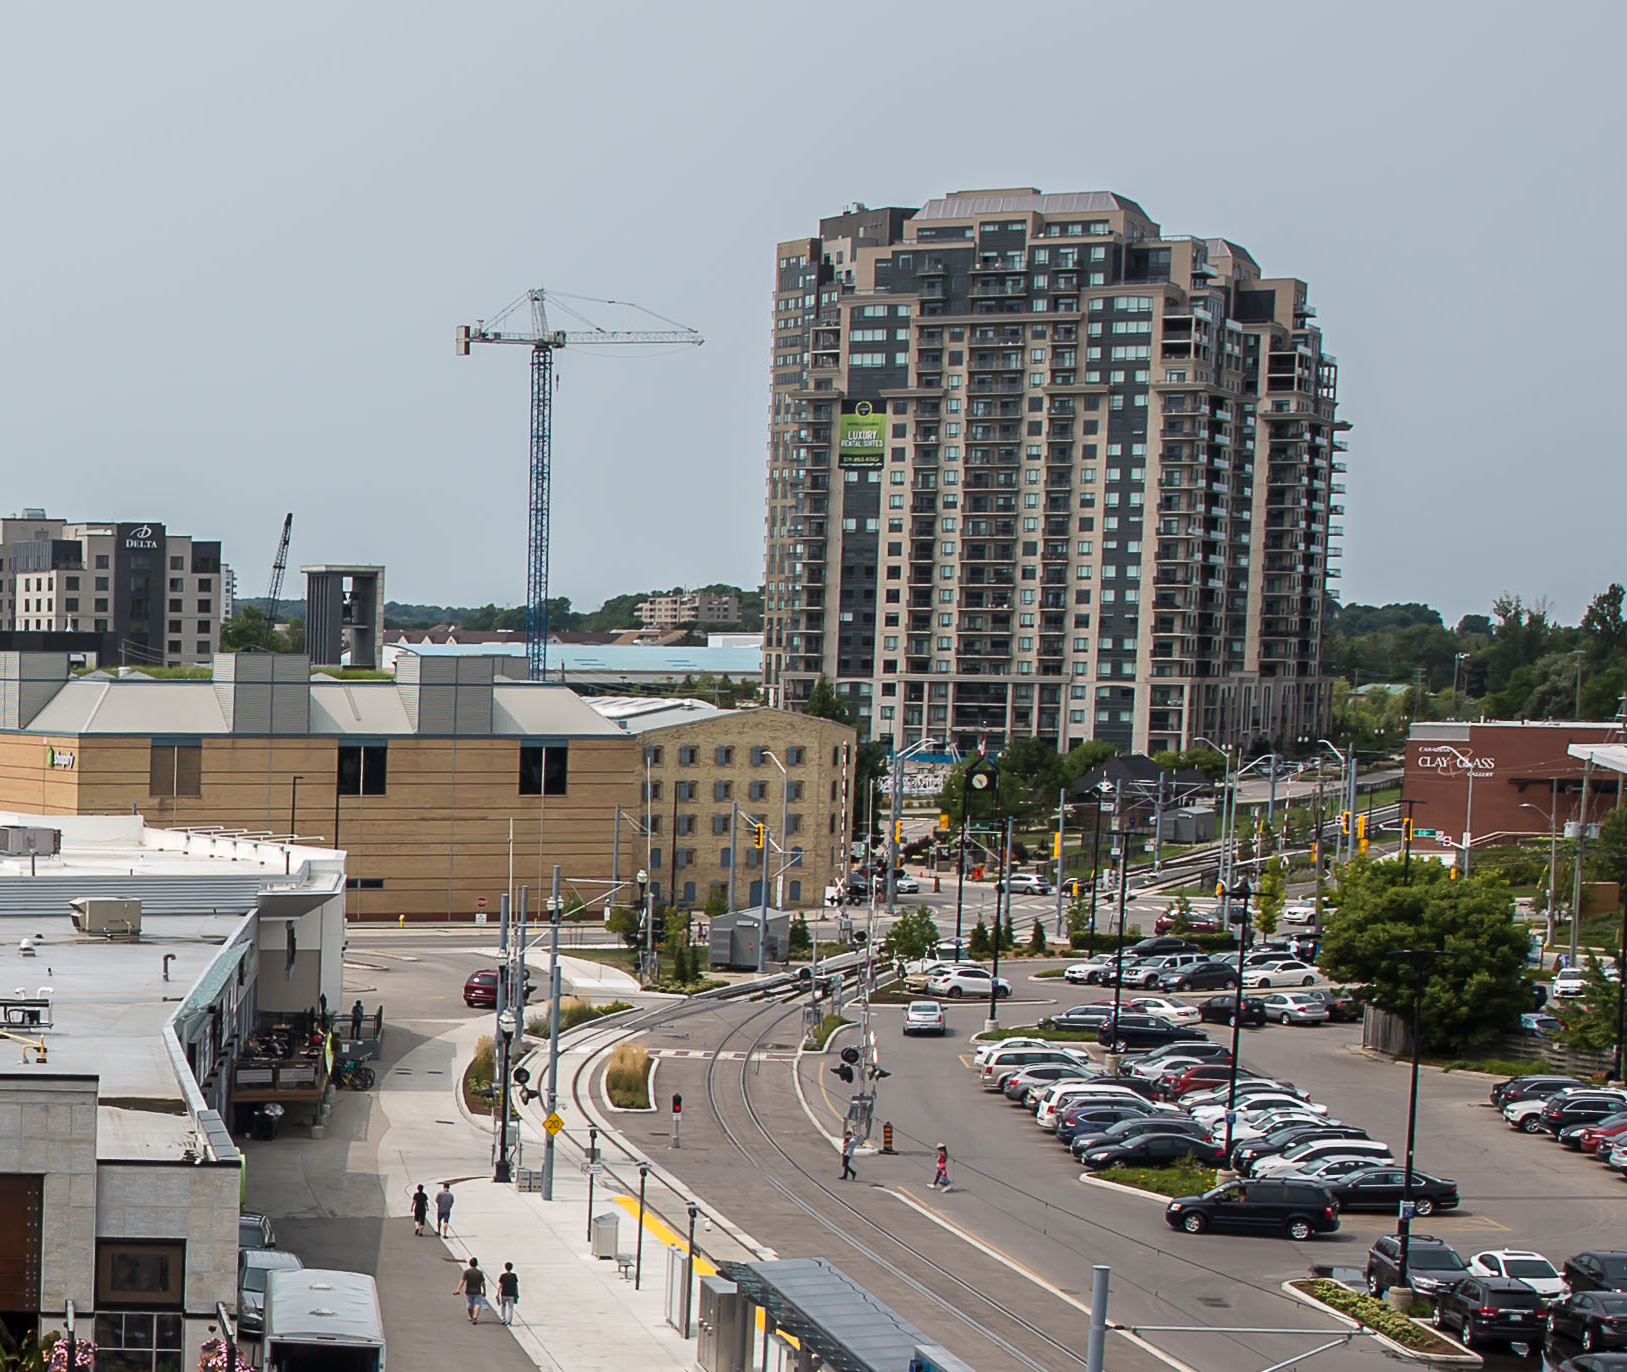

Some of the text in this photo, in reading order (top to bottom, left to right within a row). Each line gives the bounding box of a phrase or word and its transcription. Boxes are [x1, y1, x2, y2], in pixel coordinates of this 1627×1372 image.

[126, 539, 158, 549] DELTA
[53, 750, 75, 769] shopify
[1418, 756, 1448, 768] CLAY
[548, 1120, 560, 1129] 20
